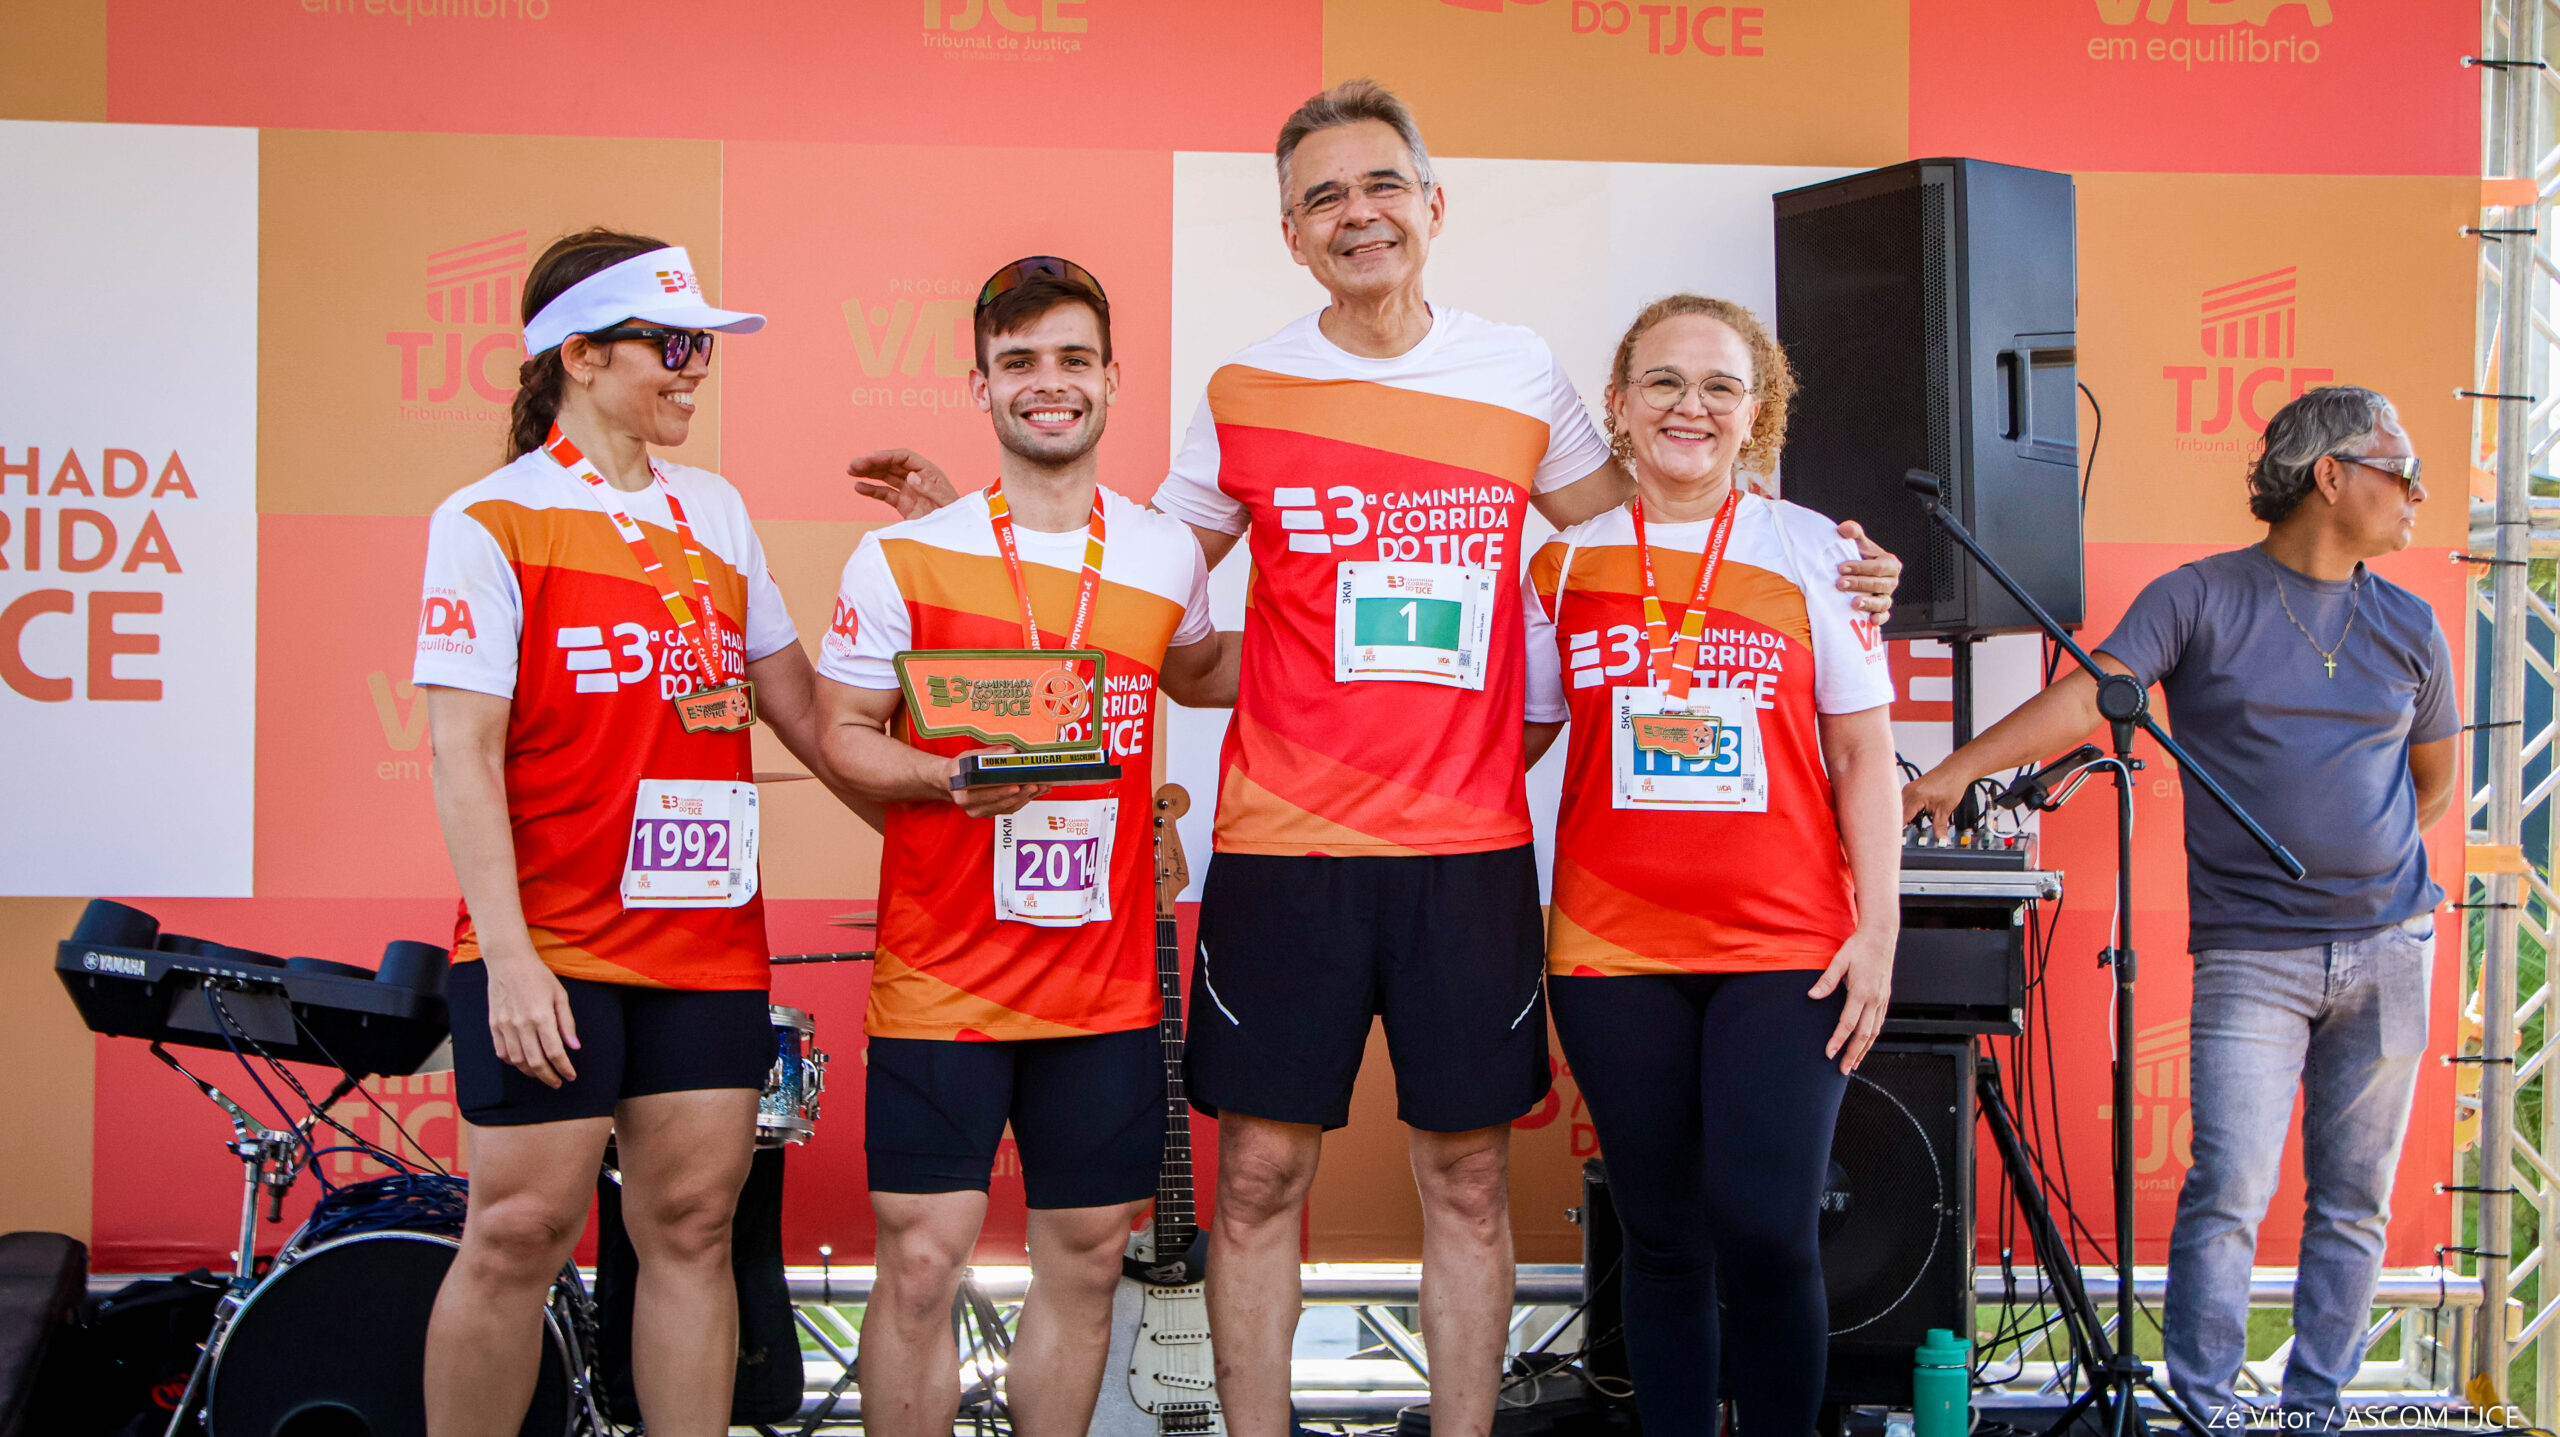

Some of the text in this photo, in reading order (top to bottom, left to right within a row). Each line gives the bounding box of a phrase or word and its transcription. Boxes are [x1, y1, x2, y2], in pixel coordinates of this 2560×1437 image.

[1571, 0, 1764, 56] DO TJCE
[922, 33, 1081, 53] Tribunal de Justiça
[2087, 29, 2320, 71] em equilíbrio
[890, 279, 981, 294] PROGRA
[841, 299, 976, 378] VID
[386, 331, 532, 404] TJC
[852, 386, 893, 406] em
[400, 406, 470, 422] Tribunal
[2175, 438, 2240, 451] Tribunal
[1326, 485, 1515, 546] 3ª CAMINHADA
[1376, 507, 1509, 535] /CORRIDA
[0, 507, 184, 574] IDA
[1377, 535, 1420, 562] DO
[1342, 581, 1352, 604] 3KM
[1399, 601, 1417, 642] 1
[970, 688, 1033, 700] /CORRIDA
[973, 680, 1034, 689] CAMINHADA
[970, 700, 1032, 716] DO TJCE
[1621, 705, 1630, 729] 5KM
[377, 760, 420, 780] em
[985, 757, 1008, 766] 10KM
[1031, 755, 1062, 765] LUGAR
[1003, 818, 1013, 850] 10KM
[1076, 828, 1088, 836] TJCE
[636, 822, 728, 868] 1992
[1018, 841, 1097, 887] 2014
[99, 953, 146, 977] YAMAHA
[324, 1100, 468, 1175] TJC
